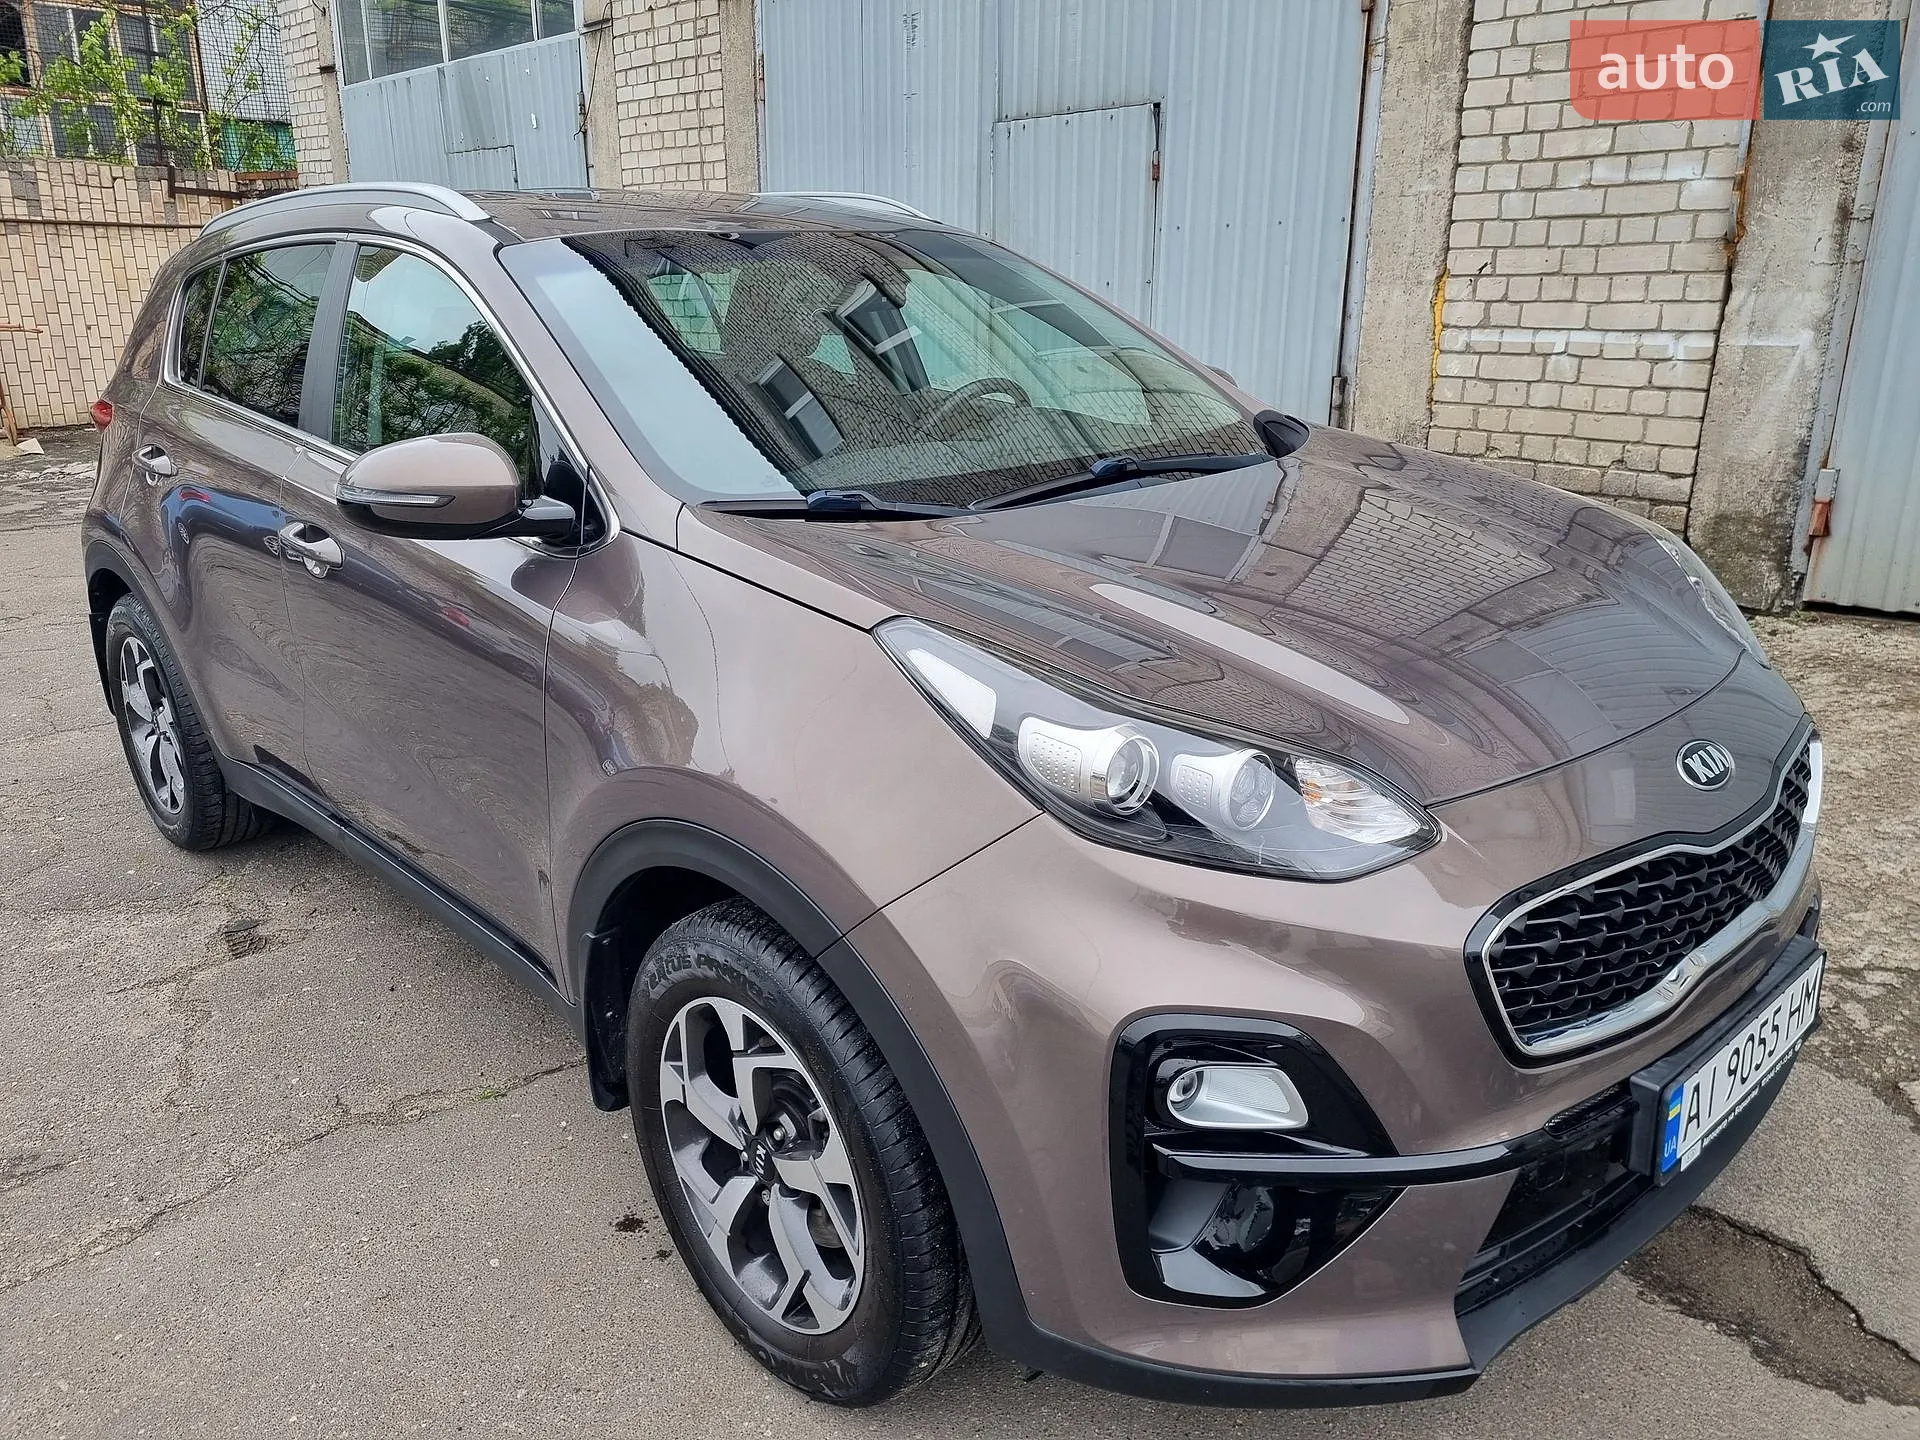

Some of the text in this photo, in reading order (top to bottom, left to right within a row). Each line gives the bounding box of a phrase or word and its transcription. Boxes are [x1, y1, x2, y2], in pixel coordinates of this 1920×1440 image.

[1684, 745, 1729, 783] KIA
[1682, 1065, 1716, 1143] AI
[1725, 1004, 1782, 1102] 9055
[1785, 967, 1820, 1041] HM
[756, 1144, 766, 1175] KIA
[1664, 1135, 1677, 1158] UA
